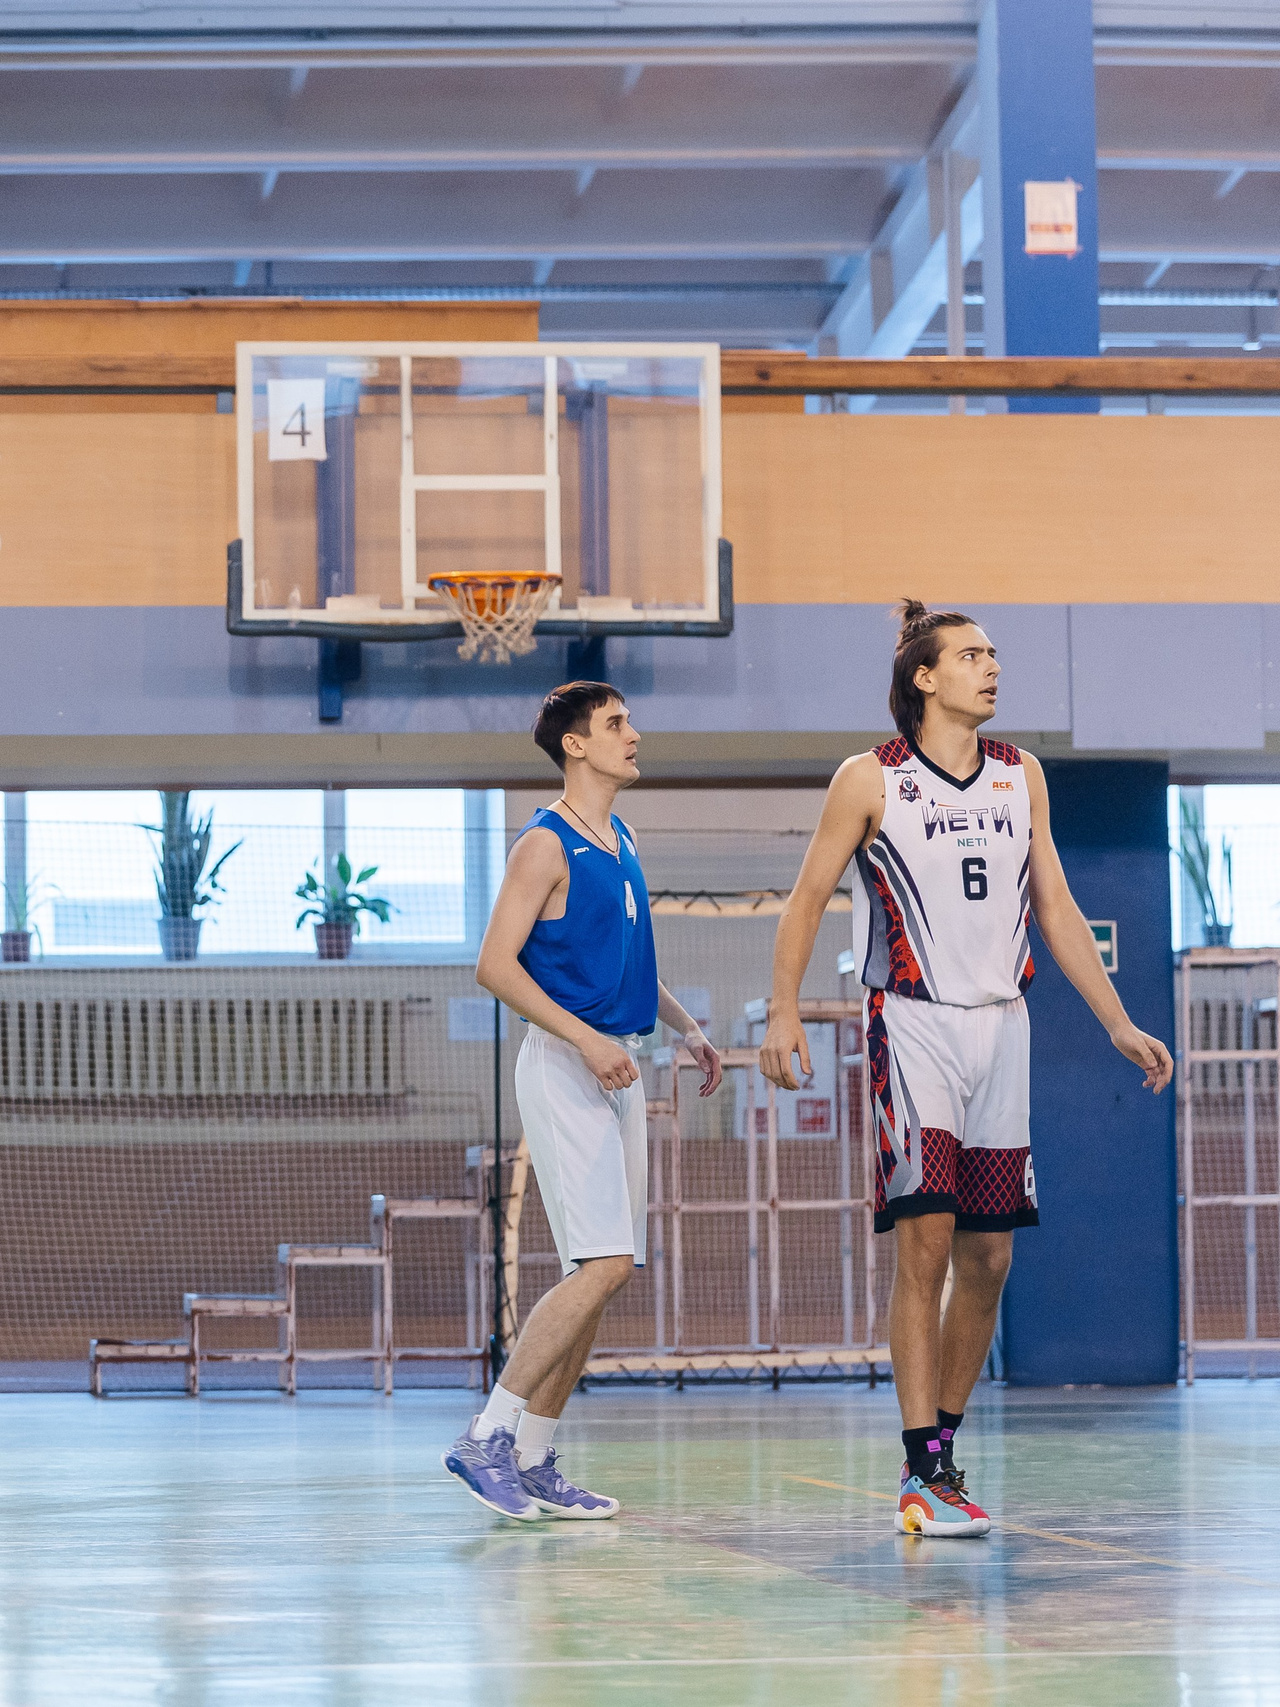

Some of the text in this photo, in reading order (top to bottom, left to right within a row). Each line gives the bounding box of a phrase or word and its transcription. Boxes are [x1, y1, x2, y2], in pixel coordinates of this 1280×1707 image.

[282, 402, 311, 447] 4
[957, 838, 988, 847] NETI
[961, 857, 989, 901] 6
[624, 880, 638, 926] 4
